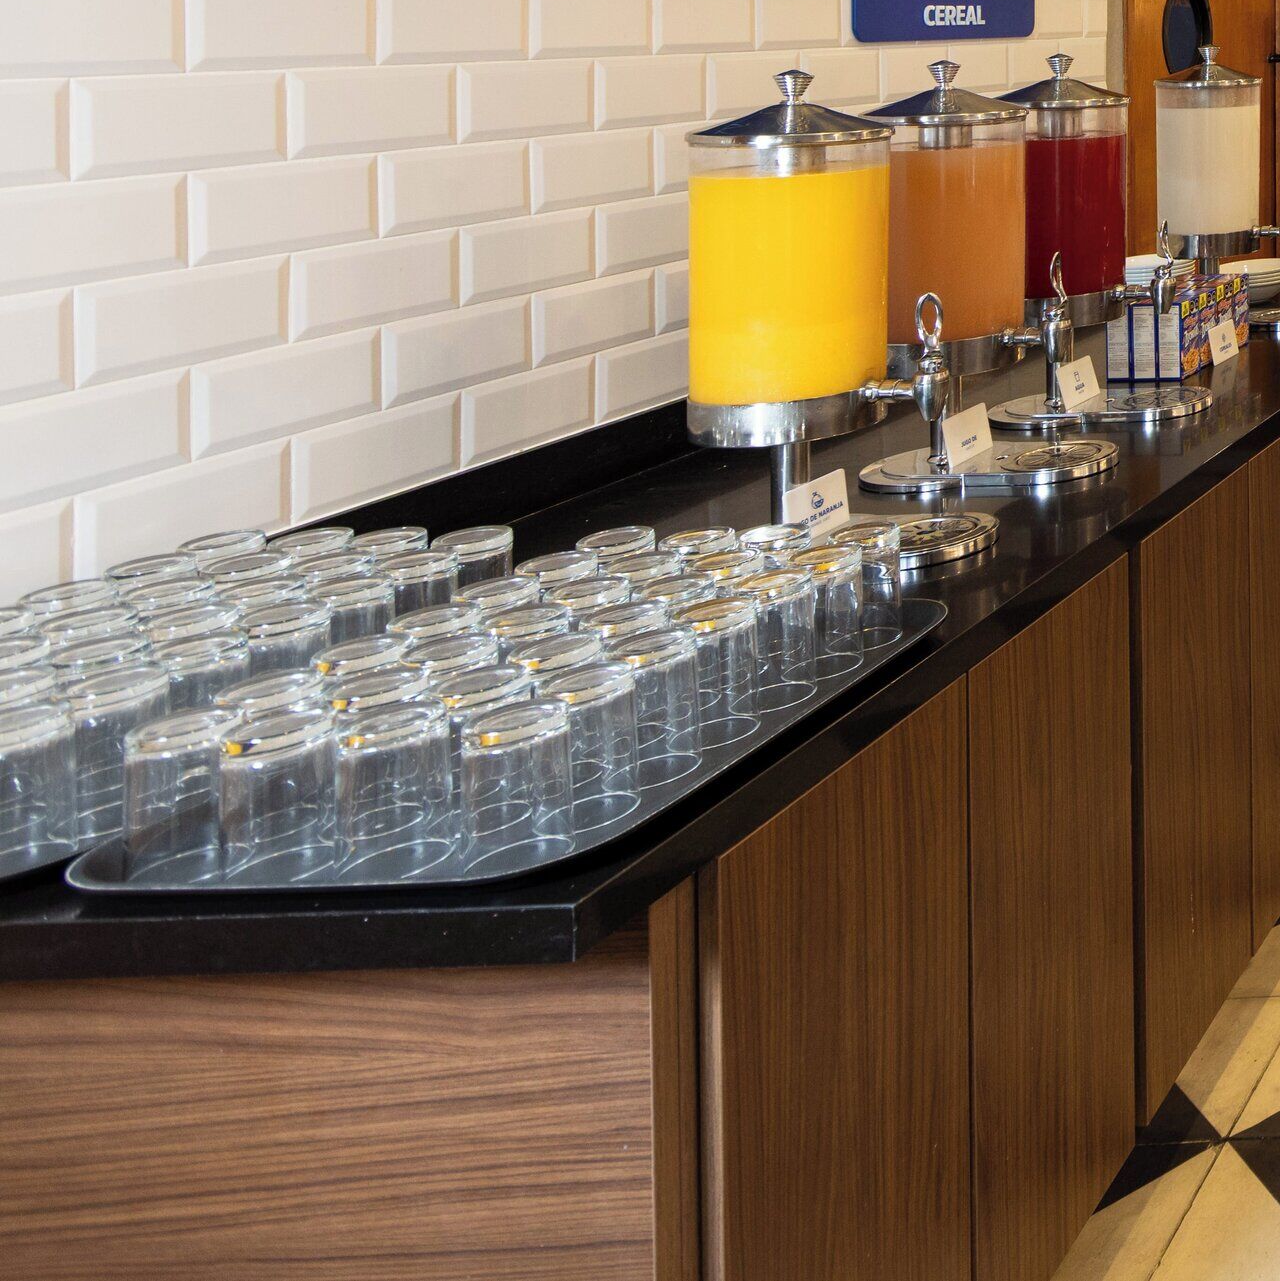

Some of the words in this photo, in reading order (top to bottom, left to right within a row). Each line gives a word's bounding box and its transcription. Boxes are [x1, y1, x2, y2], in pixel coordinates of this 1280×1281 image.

[923, 4, 986, 27] CEREAL
[809, 513, 818, 522] DE
[818, 500, 844, 518] NARANJA
